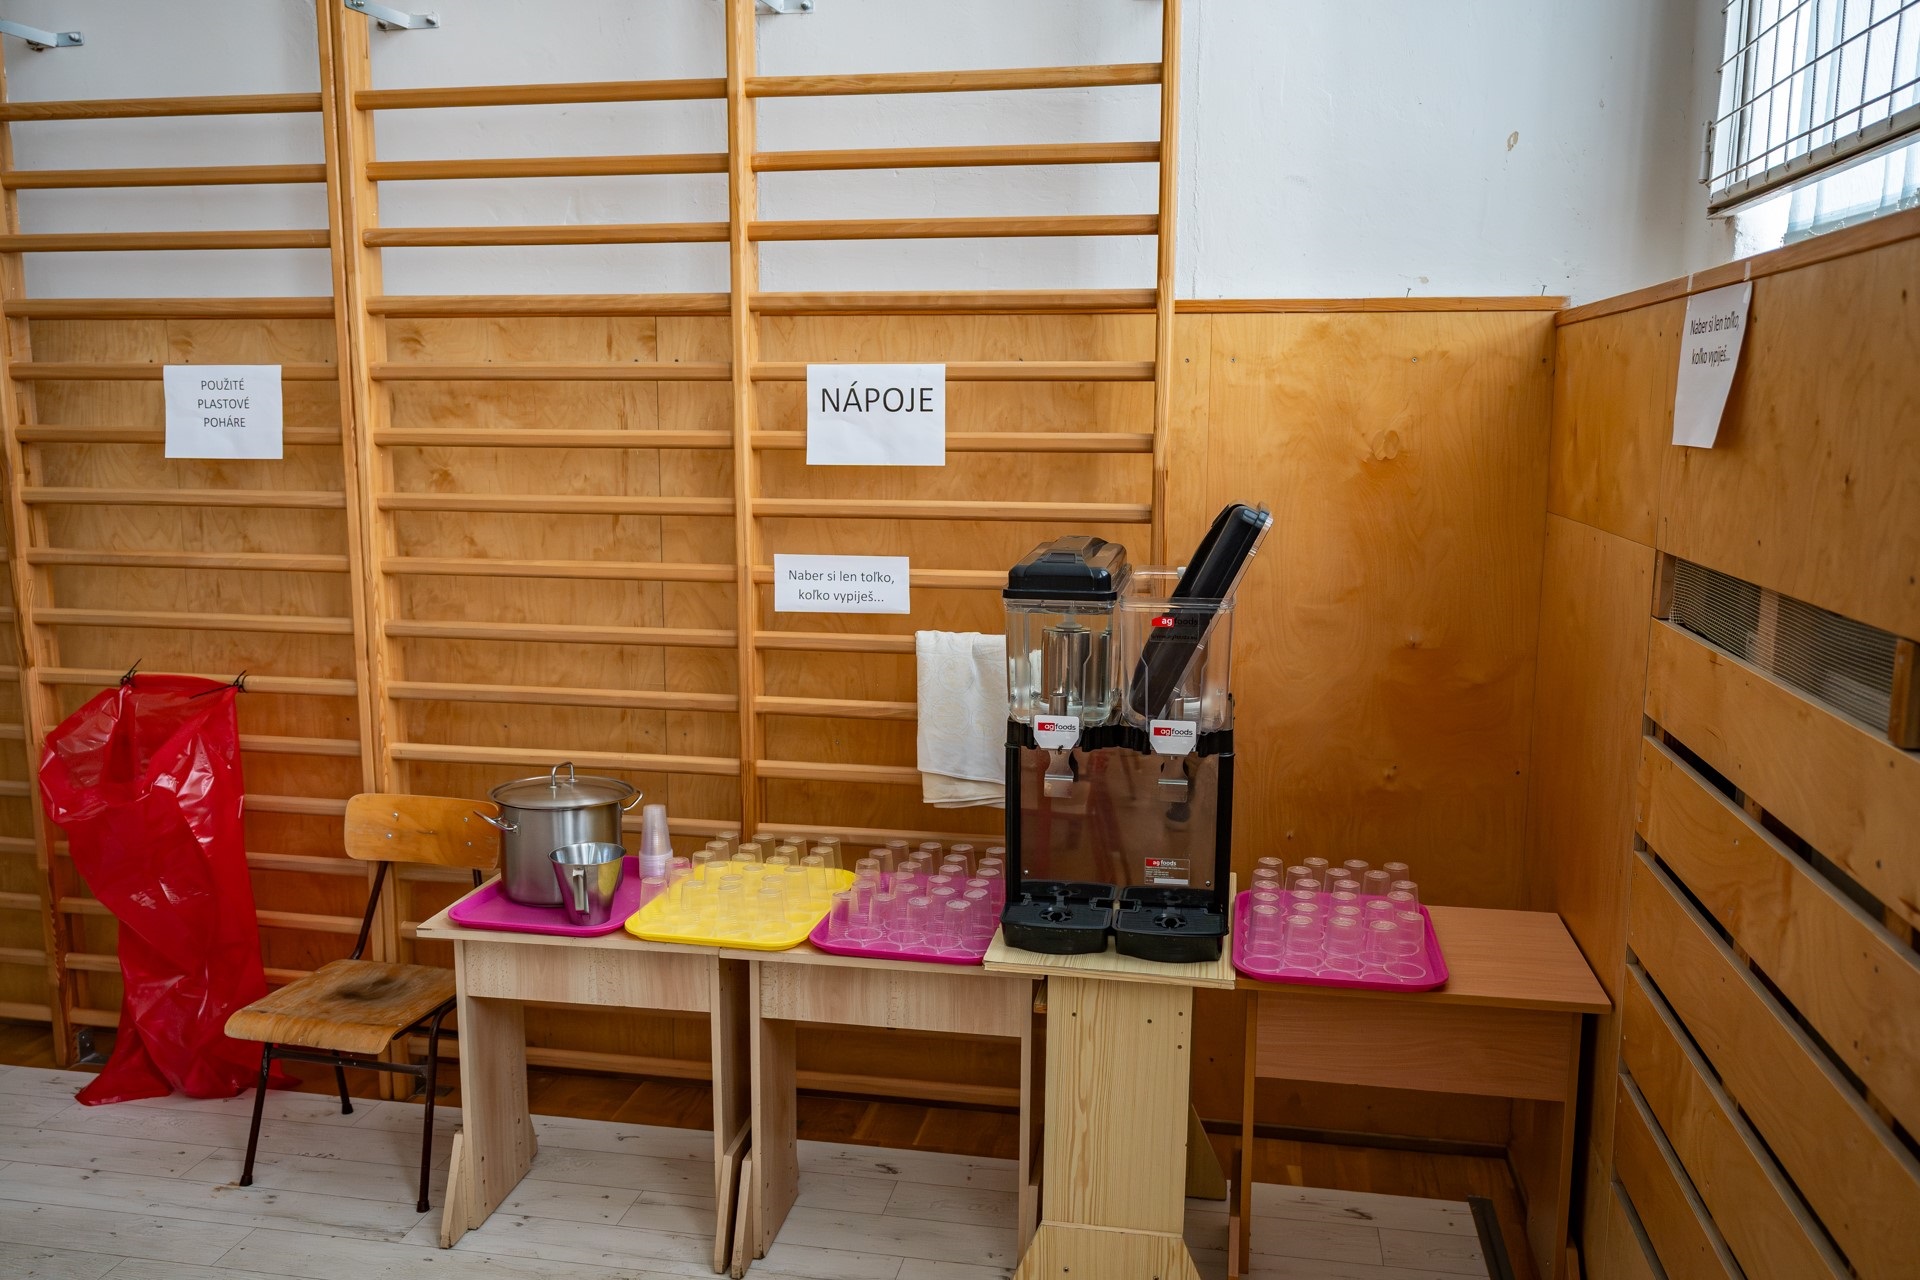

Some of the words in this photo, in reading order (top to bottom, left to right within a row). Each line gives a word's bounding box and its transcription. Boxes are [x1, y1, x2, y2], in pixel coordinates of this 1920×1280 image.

[1690, 317, 1708, 335] Naber
[1708, 316, 1714, 333] si
[1714, 315, 1723, 331] len
[201, 377, 245, 391] POUŽITÉ
[197, 396, 250, 409] PLASTOVÉ
[821, 380, 934, 413] NÁPOJE
[203, 415, 246, 428] POHÁRE
[788, 569, 824, 582] Naber
[827, 570, 836, 582] si
[839, 570, 857, 582] len
[861, 571, 895, 585] toľko,
[798, 589, 830, 601] koľko
[833, 591, 884, 604] vypiješ...
